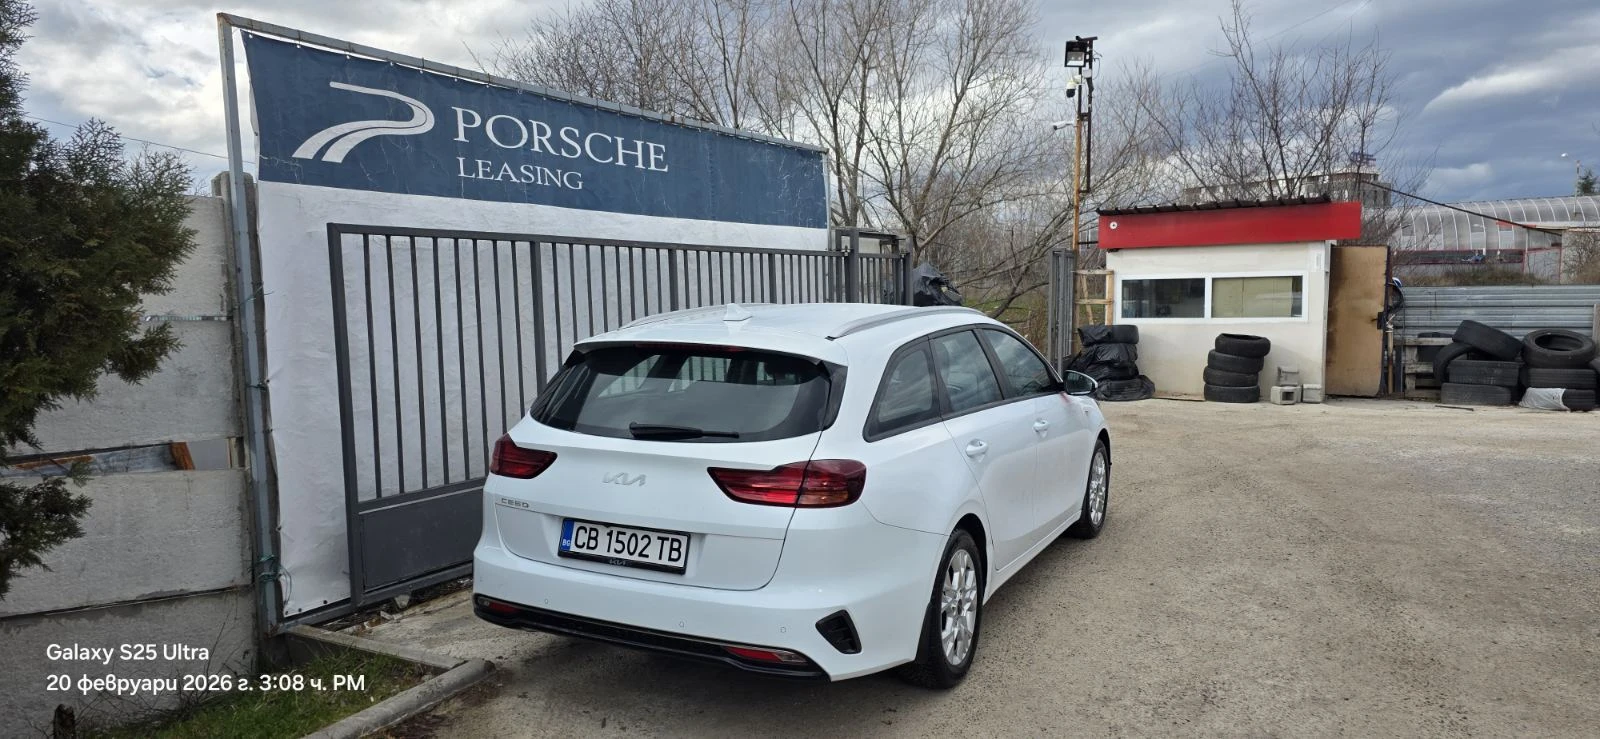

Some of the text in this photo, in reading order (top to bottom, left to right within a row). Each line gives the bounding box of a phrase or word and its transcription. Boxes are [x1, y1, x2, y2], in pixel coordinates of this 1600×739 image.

[451, 106, 669, 172] PORSCHE
[456, 156, 584, 190] LEASING
[562, 539, 571, 547] BG
[574, 526, 682, 562] CB 1502 TB
